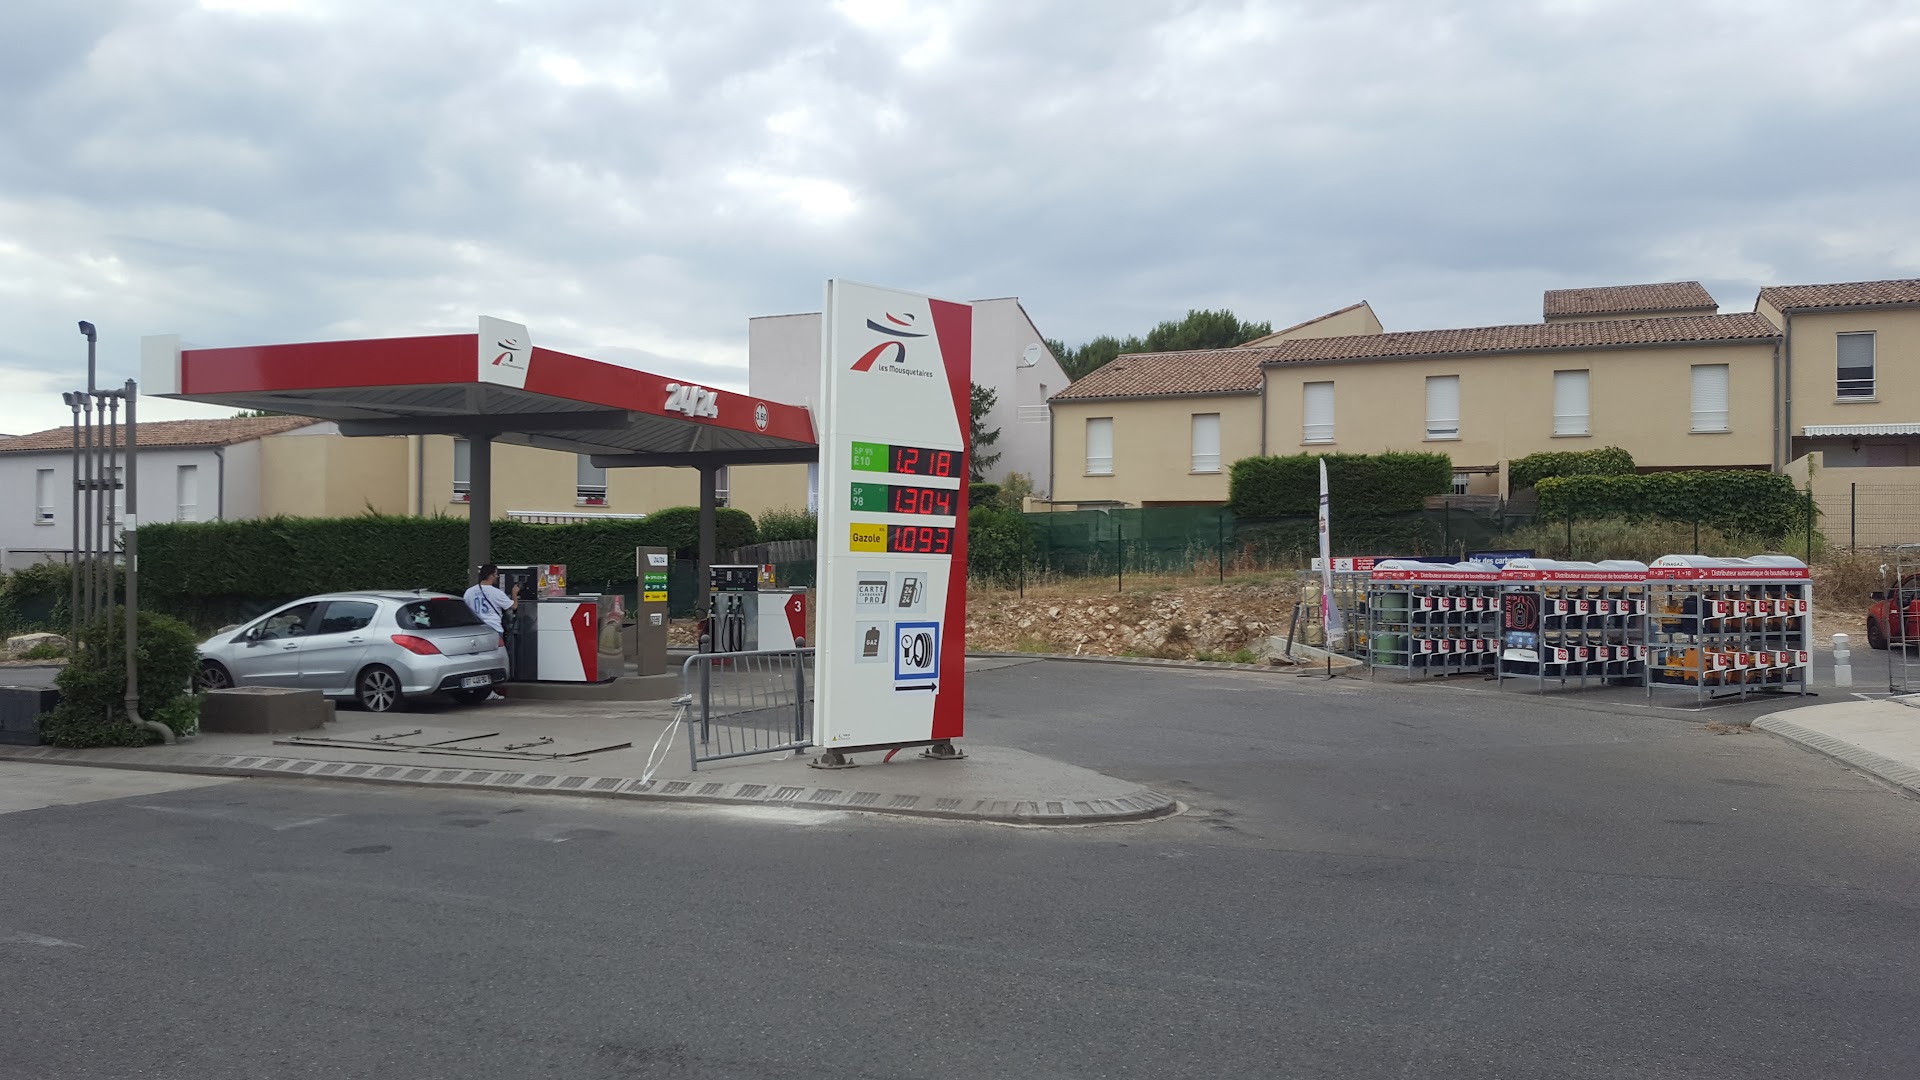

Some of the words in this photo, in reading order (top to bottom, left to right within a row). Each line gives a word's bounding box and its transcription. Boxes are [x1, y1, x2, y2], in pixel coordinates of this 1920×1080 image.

[889, 365, 933, 378] Mousquetaires
[664, 383, 718, 418] 24/24
[854, 456, 870, 466] E10
[896, 448, 951, 477] 1.218
[852, 496, 864, 506] 98
[895, 488, 950, 515] 1.304
[852, 532, 880, 543] Gazole
[894, 526, 950, 553] 1.093
[474, 597, 490, 614] 05
[794, 601, 801, 612] 3
[584, 612, 590, 626] 1
